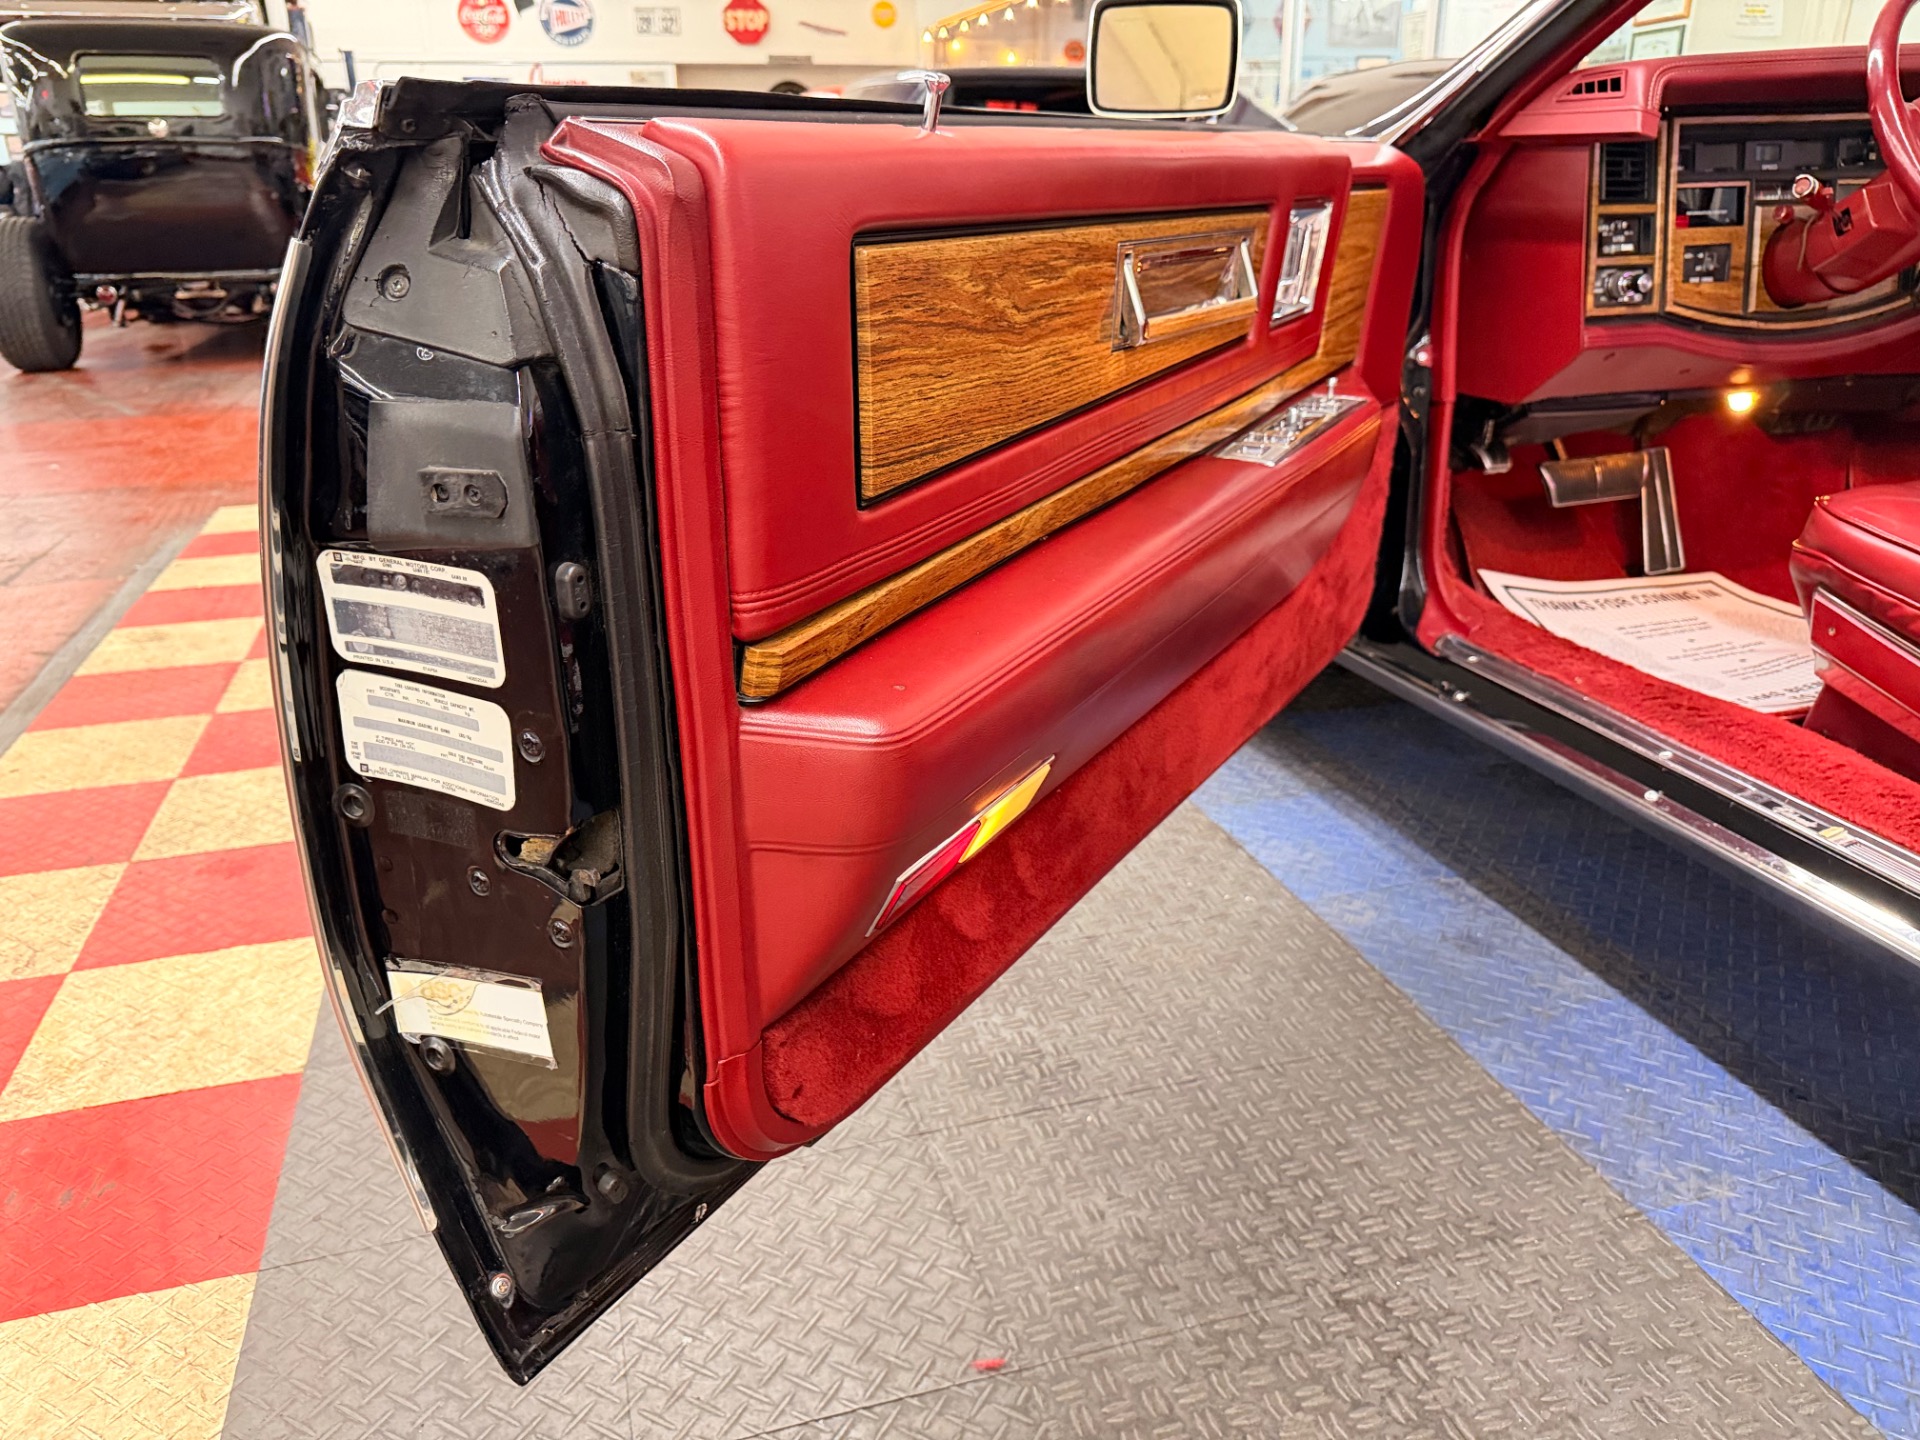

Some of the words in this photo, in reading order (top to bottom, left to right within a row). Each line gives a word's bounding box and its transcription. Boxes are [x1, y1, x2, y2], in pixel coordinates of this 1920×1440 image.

[725, 8, 769, 31] STOP
[378, 557, 404, 566] GENERAL
[430, 565, 446, 573] CORP.
[1525, 597, 1595, 611] THANKS
[1593, 597, 1633, 609] FOR
[1631, 591, 1701, 605] COMING
[353, 654, 374, 662] PRINTED
[470, 788, 500, 802] INFORMATION
[522, 1020, 544, 1029] Company
